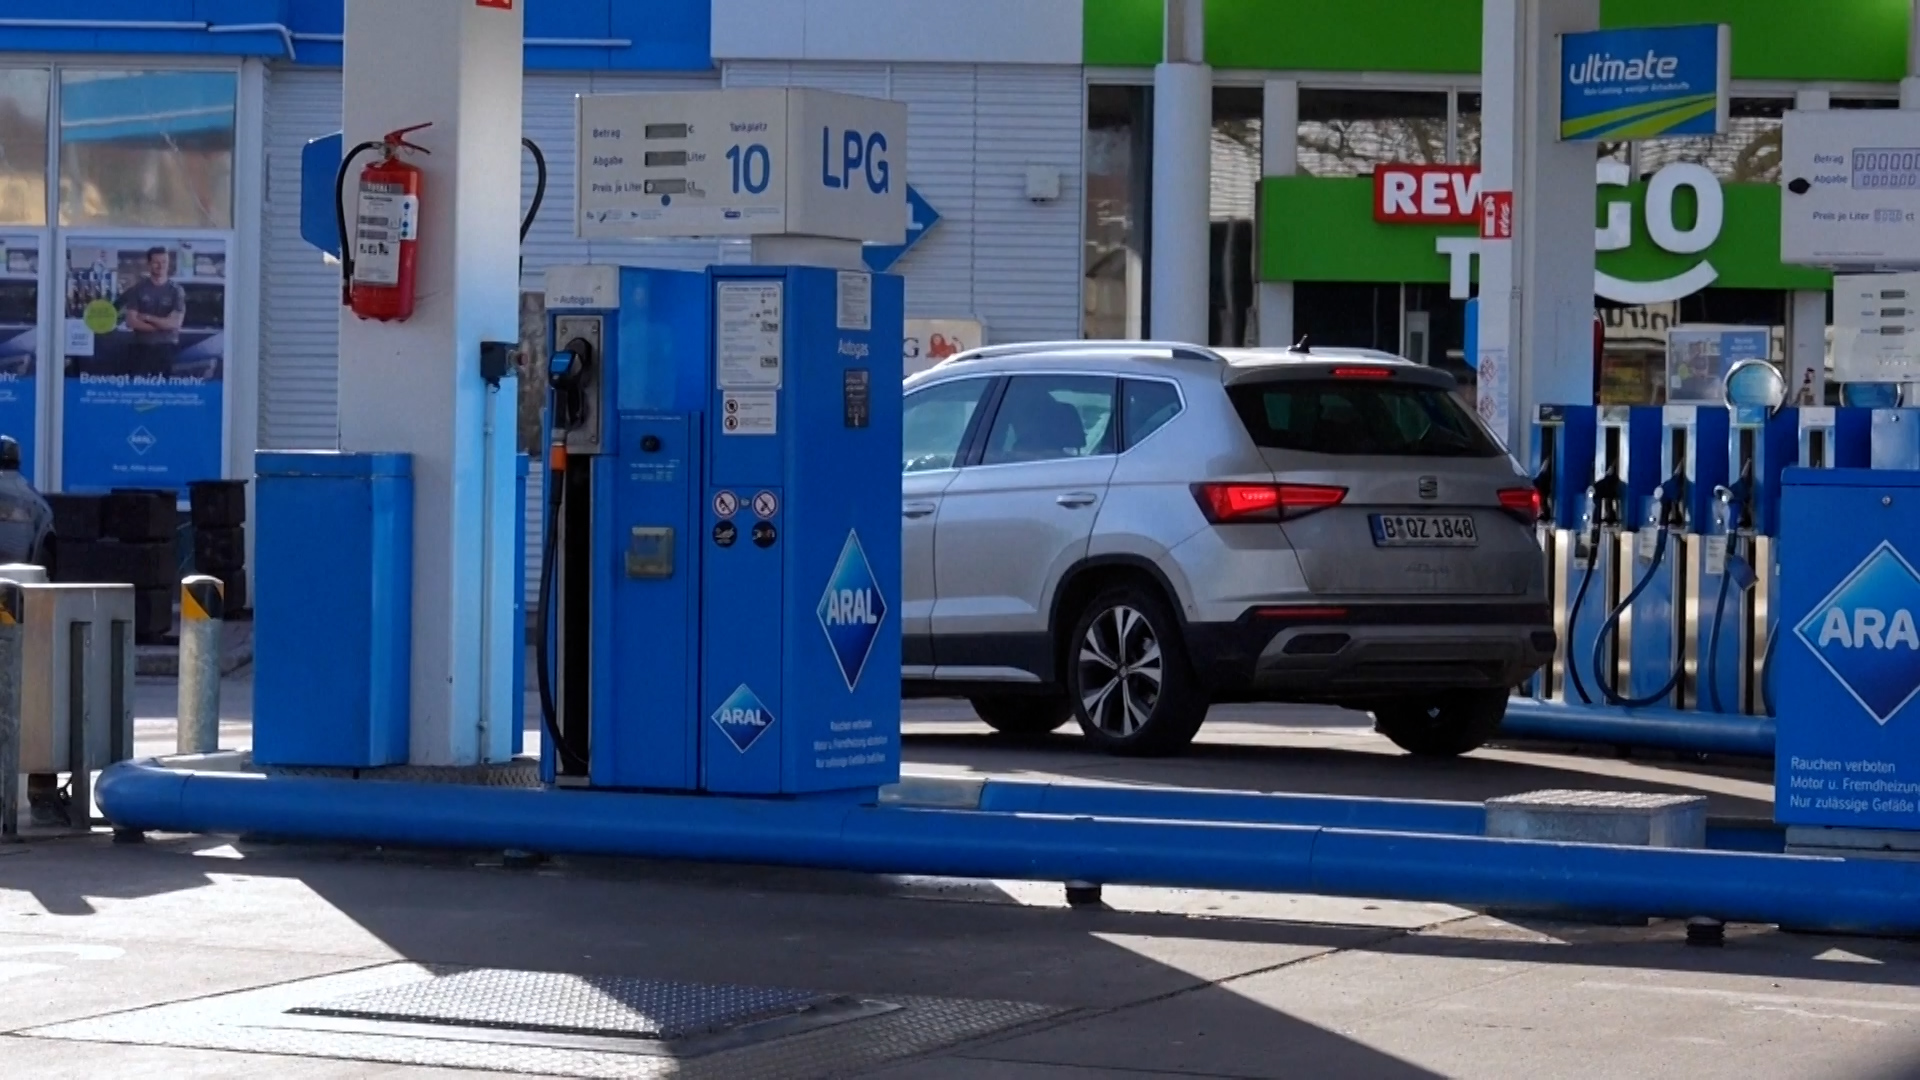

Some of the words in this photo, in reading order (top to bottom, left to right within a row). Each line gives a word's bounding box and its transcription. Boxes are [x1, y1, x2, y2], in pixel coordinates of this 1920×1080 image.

[1569, 49, 1679, 84] ultimate
[592, 128, 621, 139] Betrag
[729, 121, 768, 132] Tankplatz
[592, 156, 623, 168] Abgabe
[687, 153, 707, 162] Liter
[822, 125, 889, 195] LPG
[1813, 153, 1844, 165] Betrag
[725, 143, 771, 195] 10
[592, 182, 613, 192] Preis
[614, 183, 623, 193] je
[624, 182, 642, 192] Liter
[1813, 174, 1848, 184] Abgabe
[1383, 171, 1482, 215] REW
[1812, 211, 1836, 221] Preis
[1838, 211, 1847, 222] je
[1849, 211, 1870, 221] Liter
[1435, 236, 1481, 300] T
[559, 295, 594, 305] Autogas
[837, 338, 870, 360] Autogas
[79, 371, 130, 388] Bewegt
[133, 372, 167, 386] mich
[169, 373, 206, 386] mehr.
[1384, 517, 1396, 538] B
[1406, 517, 1430, 538] QZ
[1433, 517, 1473, 538] 1848
[826, 588, 878, 626] ARAL
[1817, 606, 1920, 650] ARA
[720, 708, 766, 726] ARAL
[1791, 755, 1841, 771] Rauchen
[1845, 757, 1896, 774] verboten
[1790, 775, 1824, 790] Motor
[1828, 780, 1839, 790] u.
[1790, 795, 1811, 809] Nur
[1815, 795, 1869, 813] zulässige
[1872, 797, 1914, 812] Gefäße
